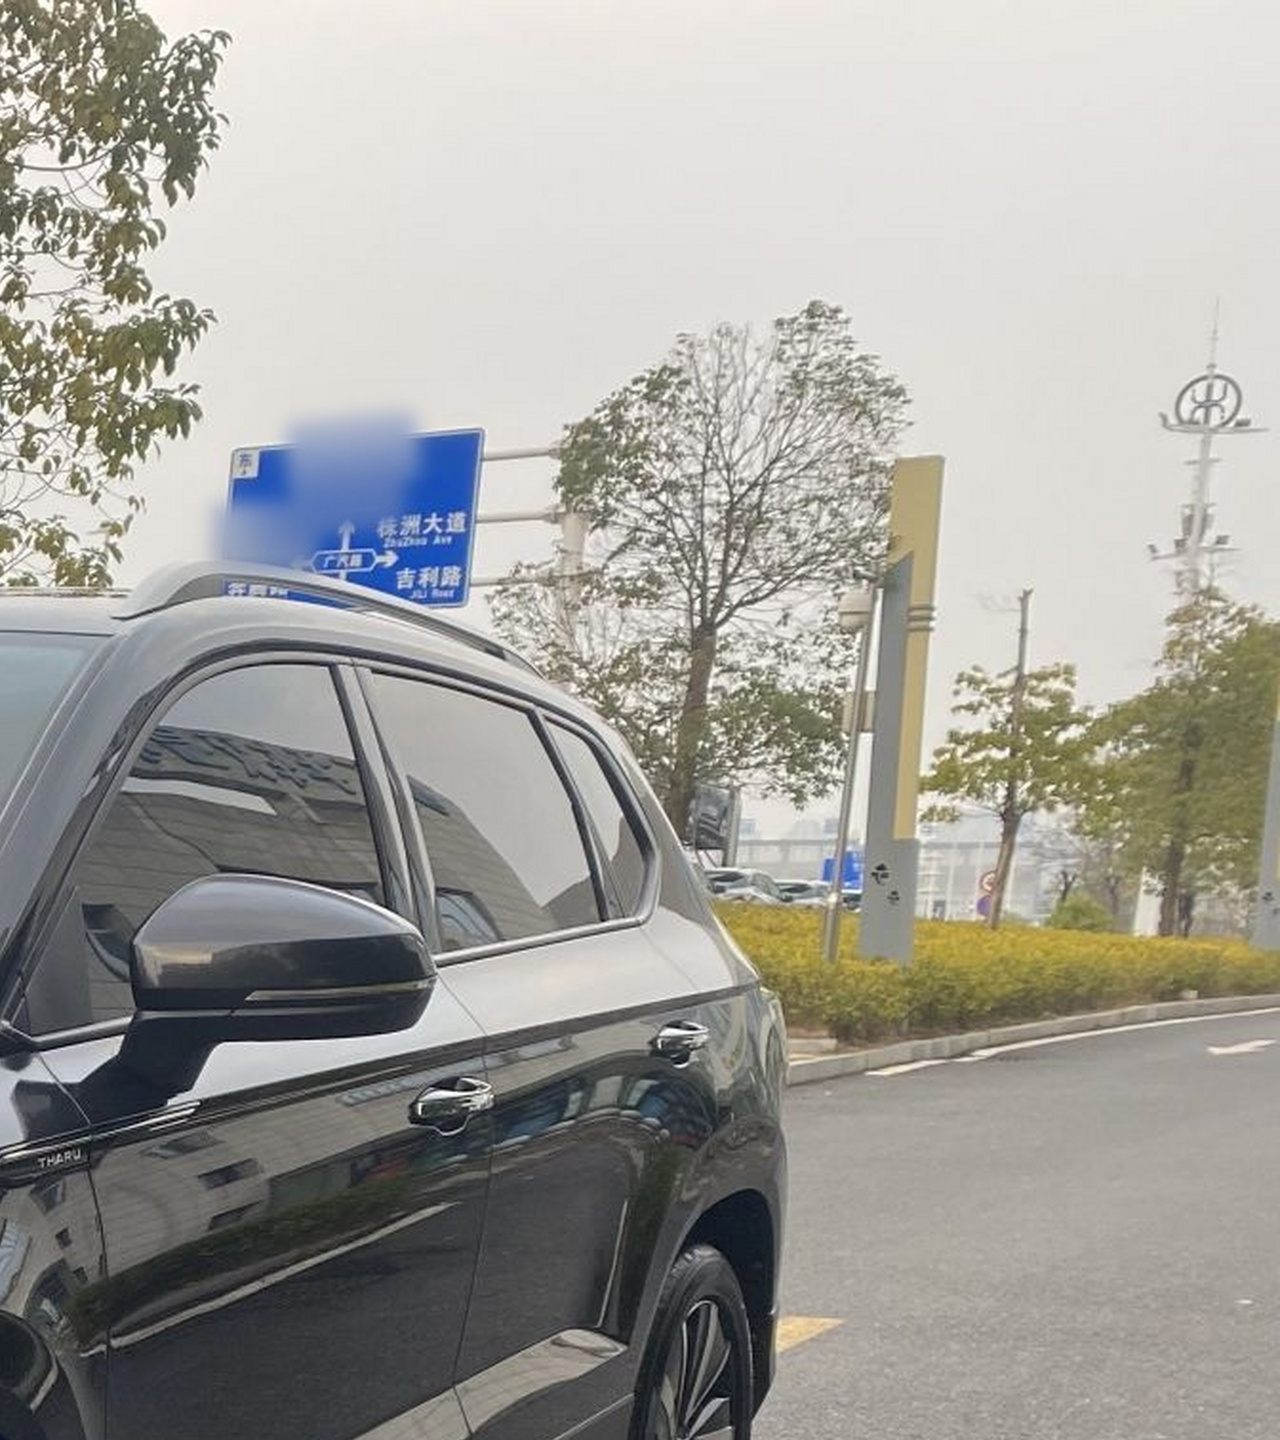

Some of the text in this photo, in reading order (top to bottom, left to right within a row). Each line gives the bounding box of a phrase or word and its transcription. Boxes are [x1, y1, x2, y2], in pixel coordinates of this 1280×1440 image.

[395, 565, 462, 590] 吉利路
[38, 1148, 82, 1169] THARU
